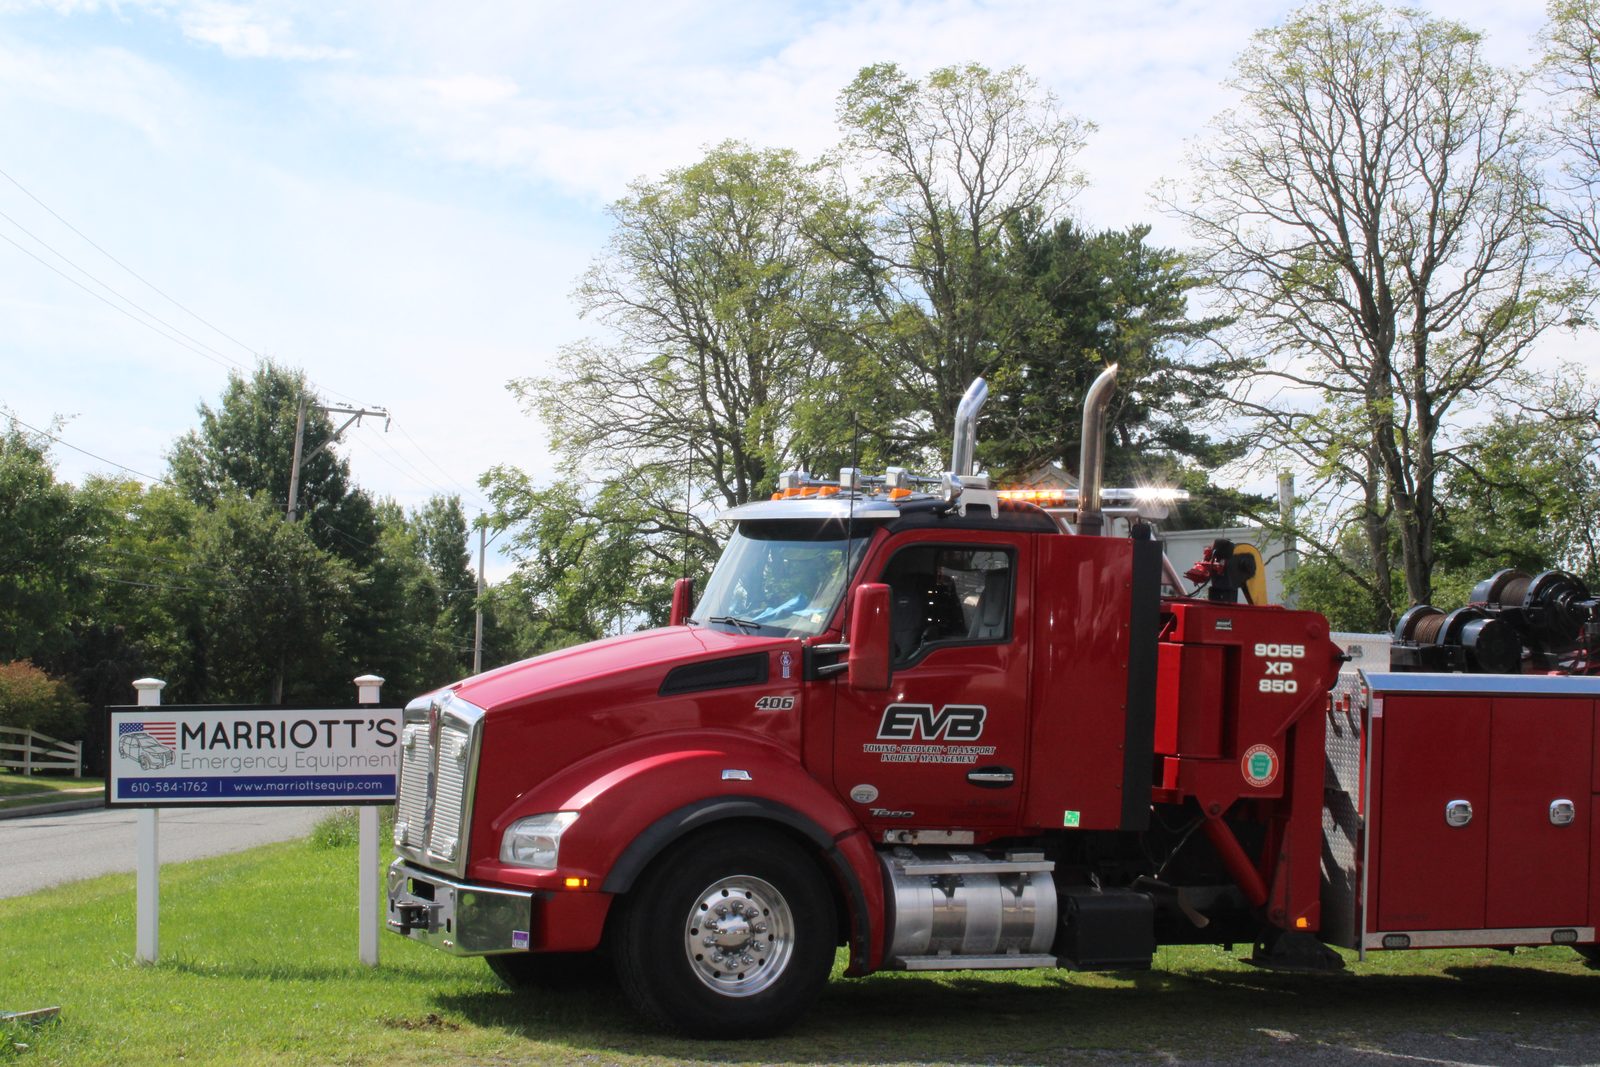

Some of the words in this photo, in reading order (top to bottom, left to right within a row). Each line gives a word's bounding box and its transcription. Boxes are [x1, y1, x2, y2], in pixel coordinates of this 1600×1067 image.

[1254, 643, 1305, 658] 9055
[1264, 661, 1293, 675] XP
[1258, 679, 1298, 693] 850
[755, 696, 795, 710] 406
[876, 703, 987, 741] EVB
[181, 718, 398, 750] MARRIOTT'S
[863, 743, 897, 753] TOWING
[900, 744, 945, 754] RECOVERY
[947, 745, 996, 755] TRANSPORT
[181, 752, 288, 773] Emergency
[295, 751, 398, 772] Equipment
[880, 753, 919, 763] INCIDENT
[919, 754, 978, 764] MANAGEMENT
[131, 781, 208, 793] 610-584-1762
[233, 780, 383, 793] www.marriottsequip.com
